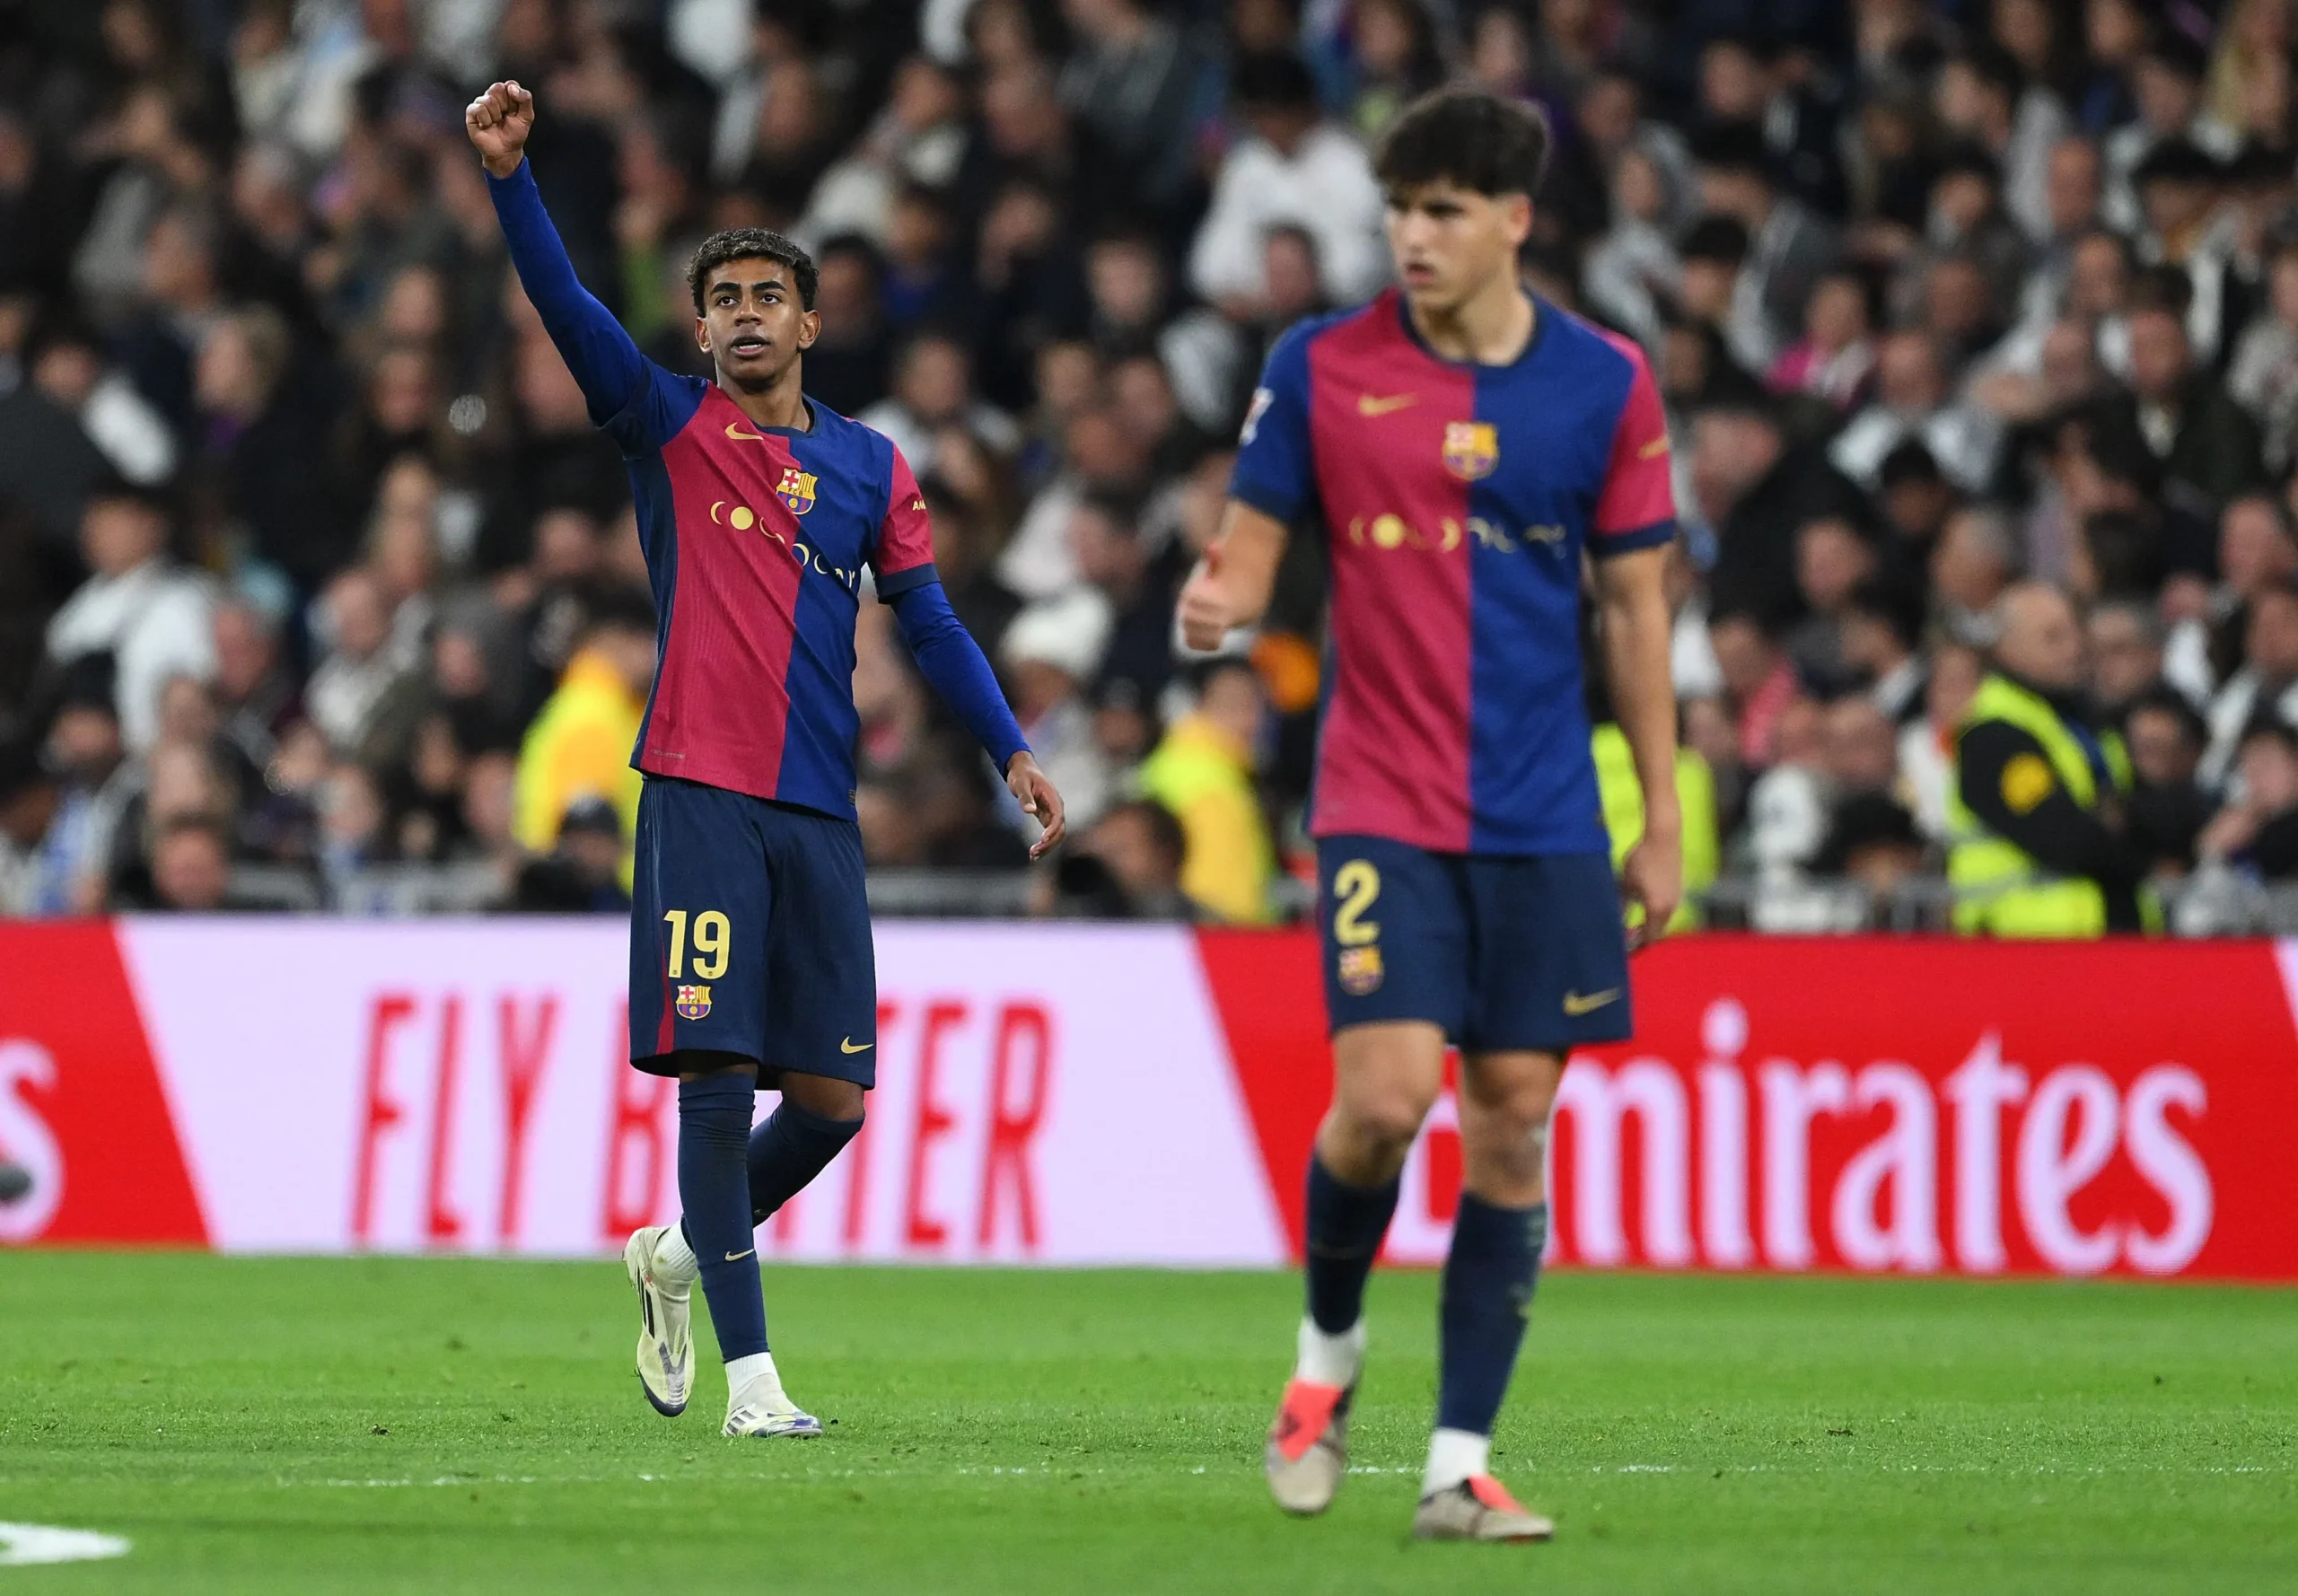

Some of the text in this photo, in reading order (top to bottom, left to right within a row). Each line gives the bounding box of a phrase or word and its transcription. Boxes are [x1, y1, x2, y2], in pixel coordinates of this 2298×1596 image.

[787, 487, 803, 496] FCB
[1334, 859, 1381, 945] 2
[663, 910, 731, 979] 19
[353, 993, 1052, 1246] FLY BTER
